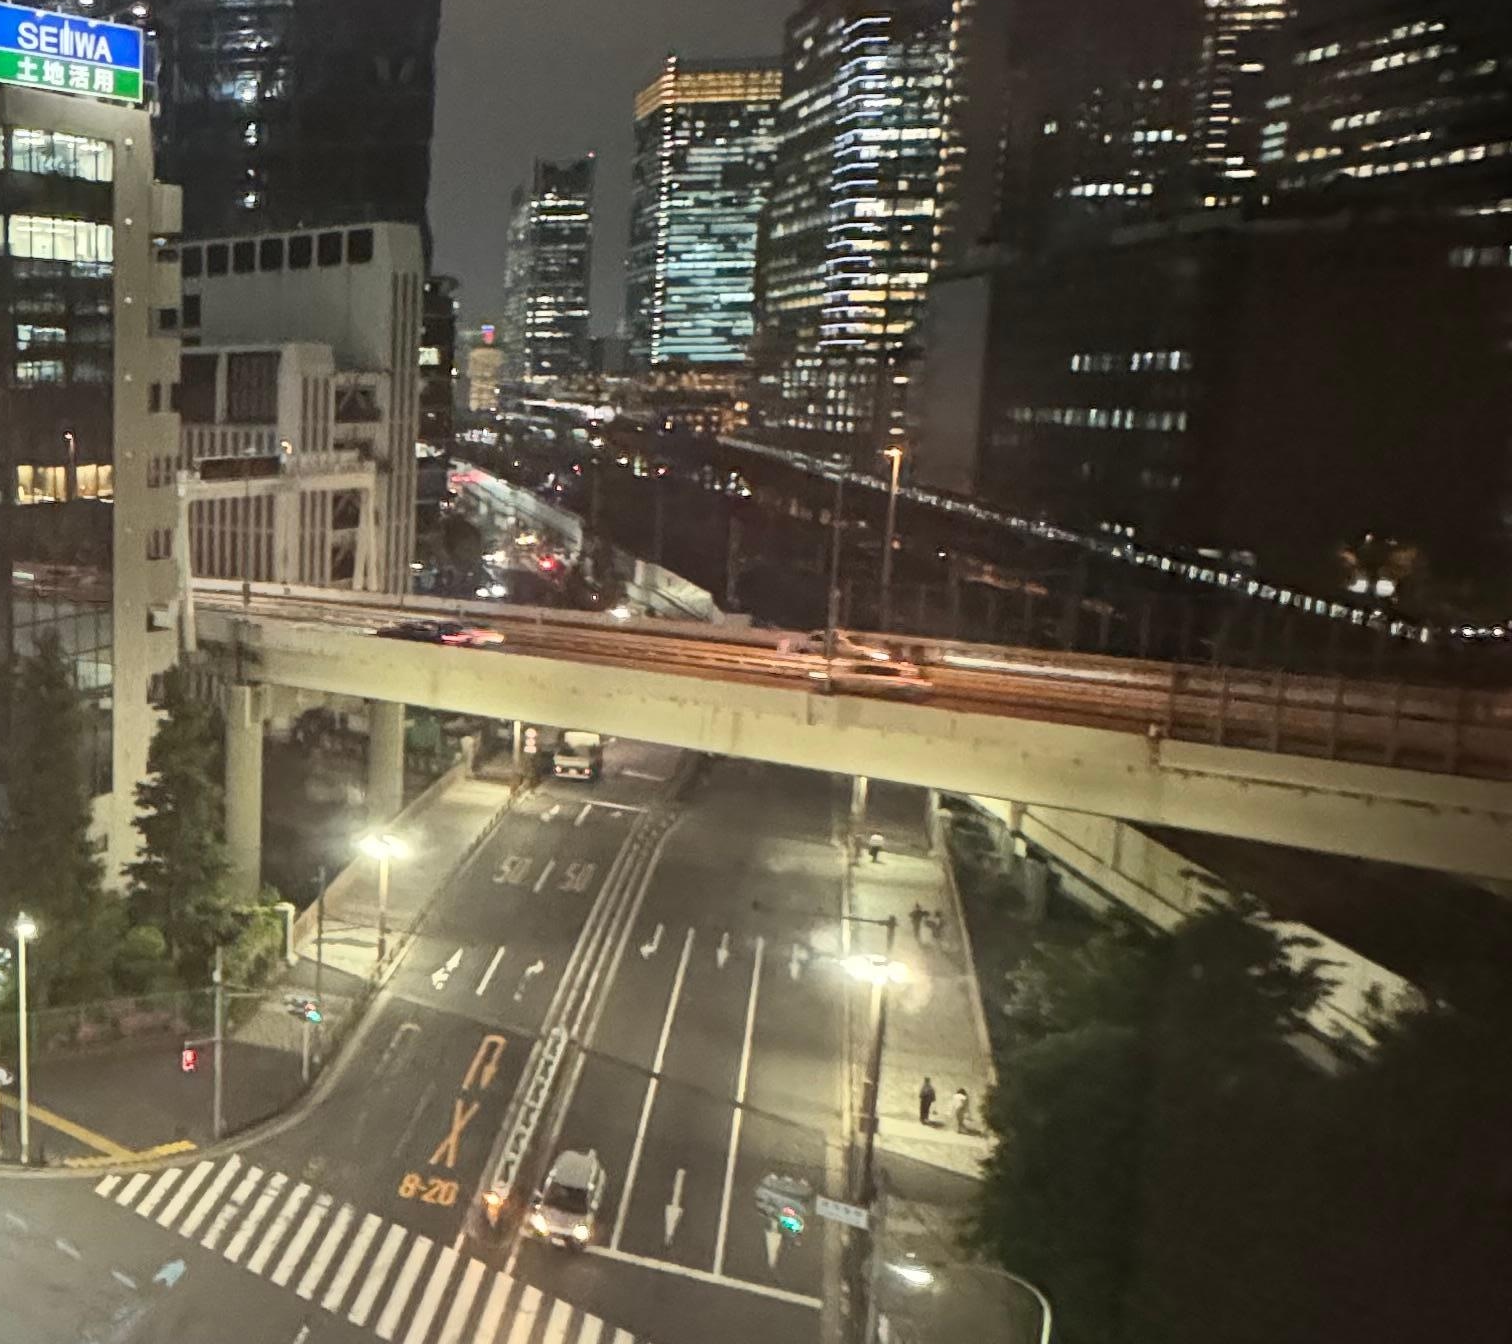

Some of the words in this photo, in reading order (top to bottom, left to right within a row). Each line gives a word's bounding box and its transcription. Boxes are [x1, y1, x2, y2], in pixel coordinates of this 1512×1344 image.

[17, 19, 113, 63] SEIWA
[16, 56, 115, 93] 土地活用
[398, 1171, 459, 1206] 8-20
